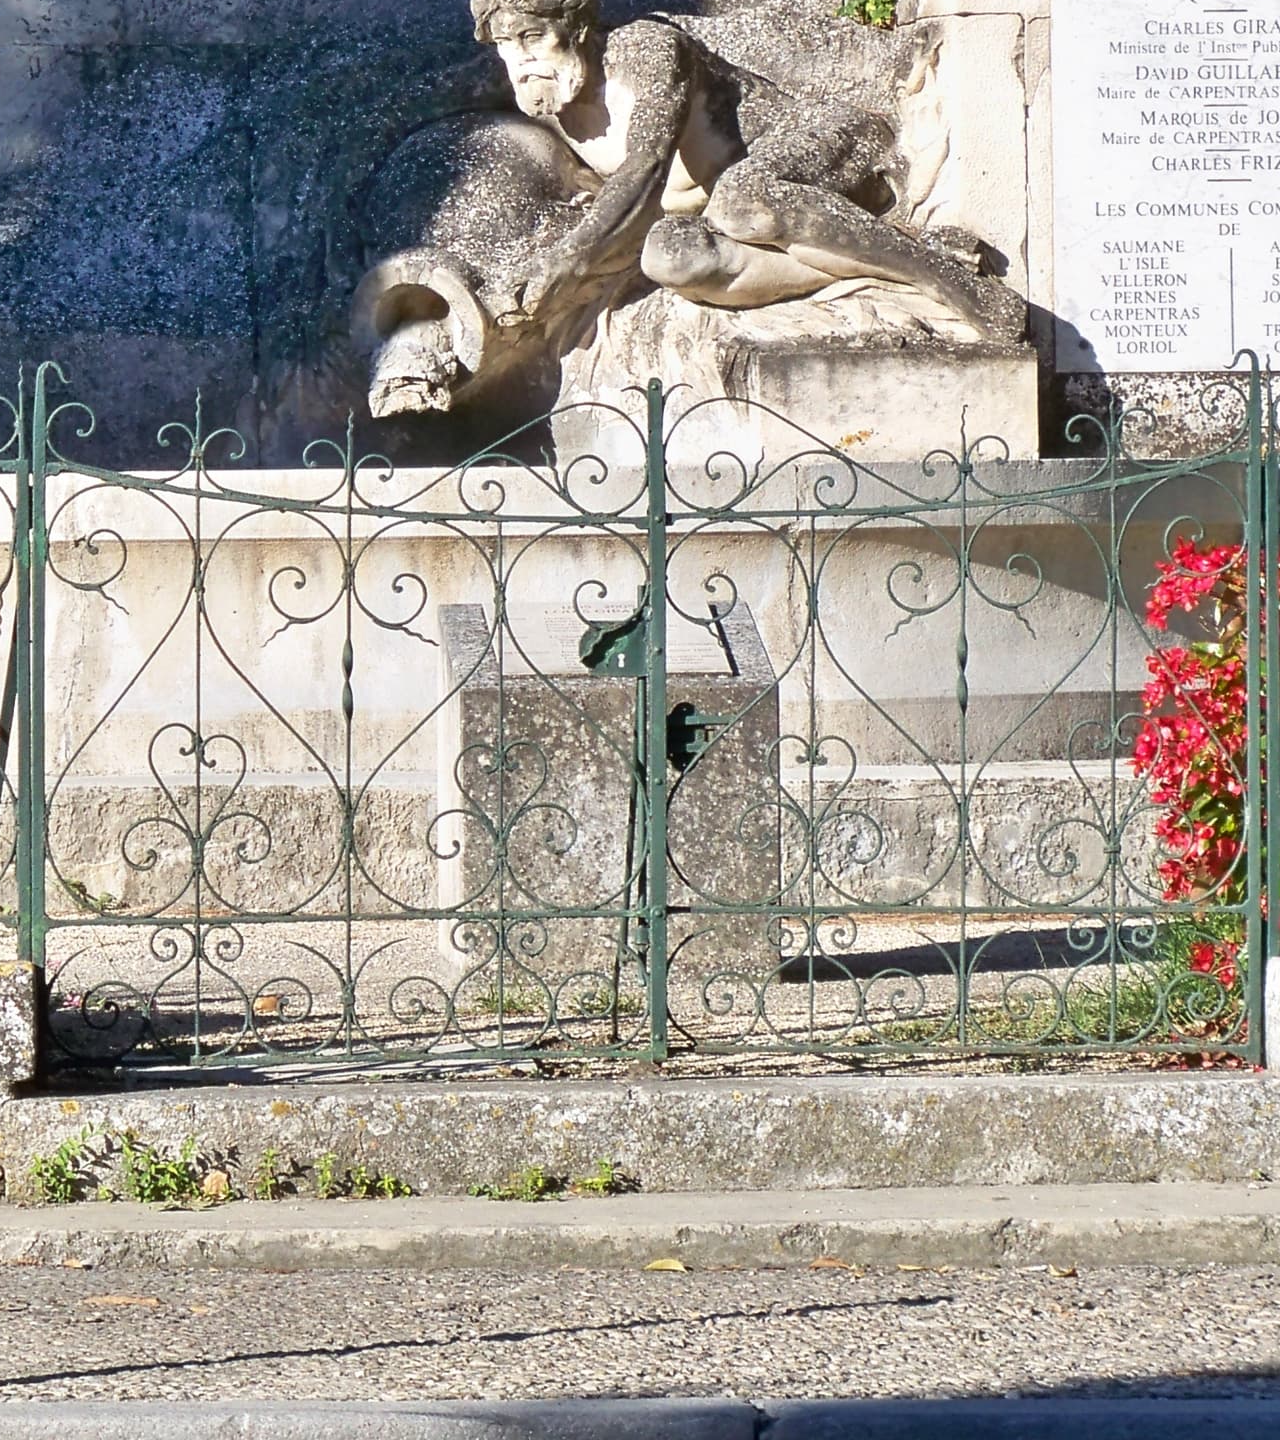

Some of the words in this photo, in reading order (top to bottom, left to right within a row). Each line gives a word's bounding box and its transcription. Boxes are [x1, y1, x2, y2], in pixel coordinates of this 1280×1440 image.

[1144, 19, 1225, 36] CHARLES
[1108, 41, 1167, 55] Ministre
[1174, 40, 1190, 55] de
[1135, 65, 1189, 81] DAVID
[1097, 86, 1137, 100] Maire
[1144, 86, 1161, 100] de
[1169, 85, 1280, 100] CARPENTRAS
[1140, 110, 1220, 127] MARQUIS
[1229, 111, 1249, 126] de
[1101, 132, 1141, 145] Maire
[1149, 131, 1166, 145] de
[1151, 155, 1232, 172] CHARLES
[1095, 201, 1127, 217] LES
[1135, 201, 1240, 217] COMMUNES
[1219, 223, 1241, 237] DE
[1102, 240, 1186, 254] SAUMANE
[1101, 274, 1188, 287] VELLERON
[1114, 291, 1177, 304] PERNES
[1090, 307, 1201, 322] CARPENTRAS
[1105, 324, 1189, 338] MONTEUX
[1117, 341, 1178, 355] LORIOL
